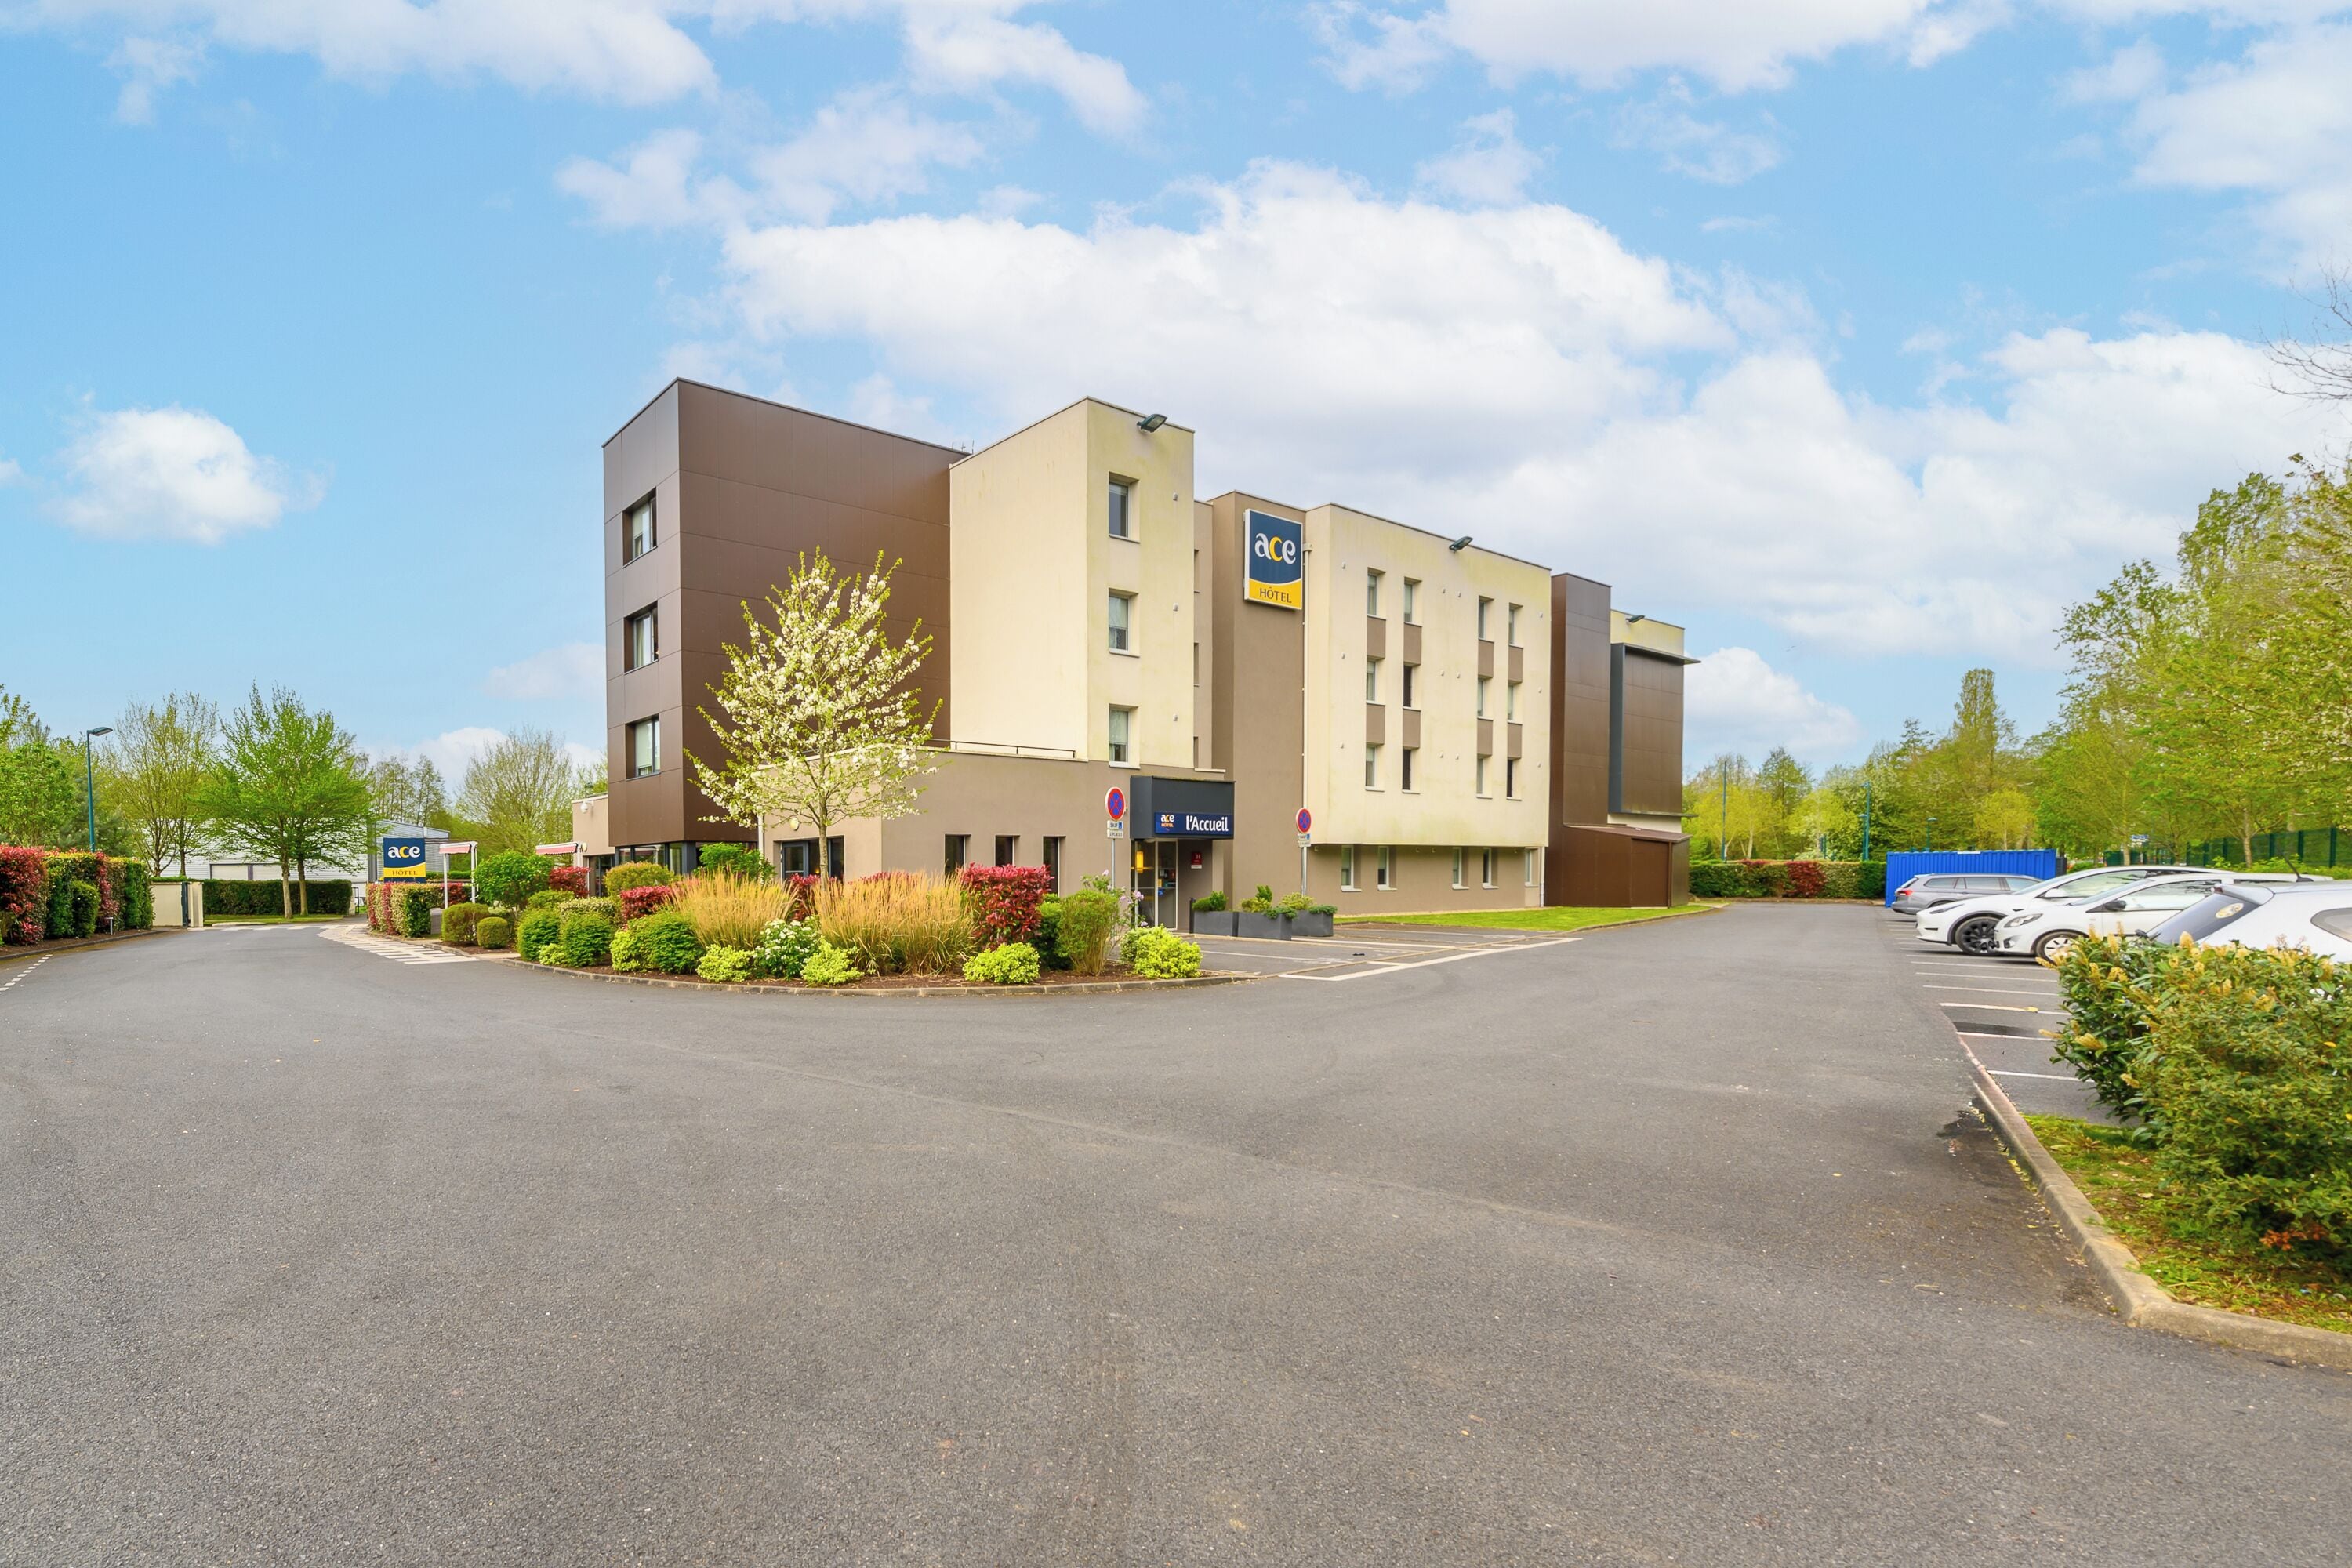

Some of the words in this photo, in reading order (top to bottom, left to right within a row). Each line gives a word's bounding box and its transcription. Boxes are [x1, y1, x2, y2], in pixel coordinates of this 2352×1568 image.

[1254, 532, 1296, 564] ace
[1259, 586, 1292, 603] HÔTEL
[1185, 815, 1229, 832] l'Accueil
[387, 846, 420, 858] ace
